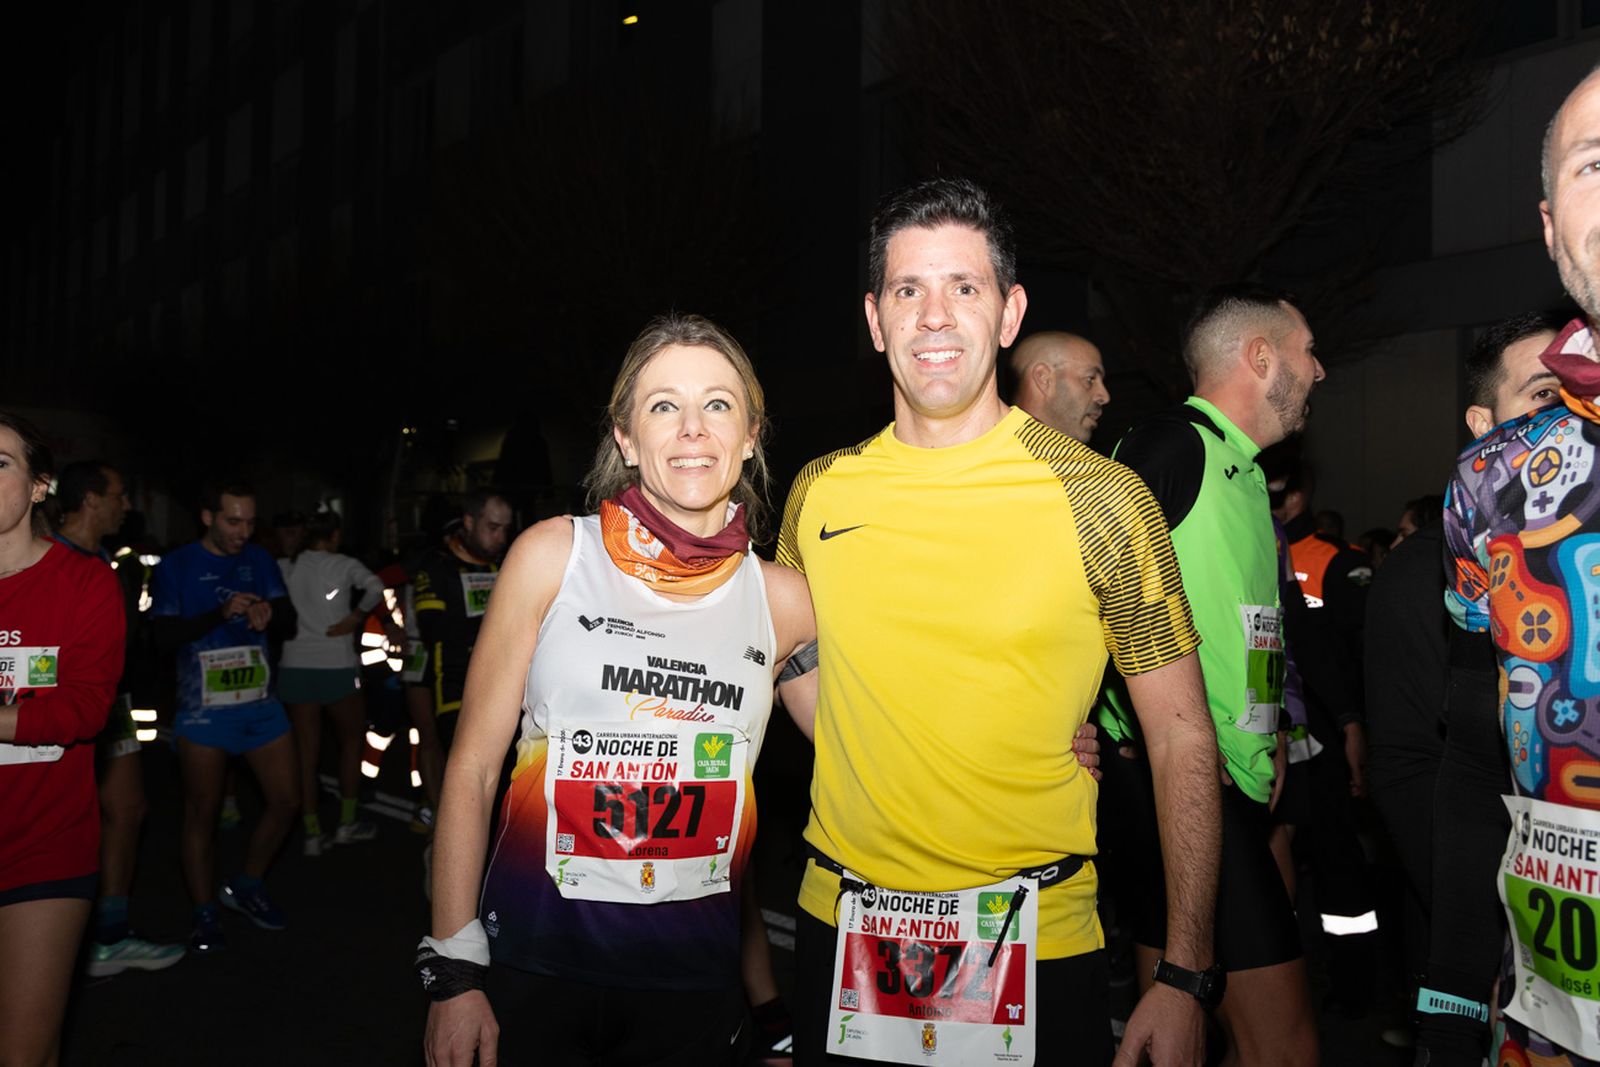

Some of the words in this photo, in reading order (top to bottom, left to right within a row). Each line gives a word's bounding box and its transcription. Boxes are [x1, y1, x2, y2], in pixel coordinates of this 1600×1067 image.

[607, 617, 635, 627] VALENCIA
[636, 628, 666, 639] ALFONSO
[1253, 635, 1268, 649] SAN
[220, 667, 256, 685] 4177
[646, 655, 708, 676] VALENCIA
[601, 664, 745, 711] MARATHON
[573, 733, 592, 748] 43
[595, 739, 653, 756] NOCHE
[657, 740, 679, 757] DE
[570, 760, 610, 779] SAN
[612, 758, 678, 780] ANTÓN
[593, 784, 706, 839] 5127
[1533, 818, 1555, 830] CARRERA
[1555, 823, 1578, 835] URBANA
[628, 846, 669, 857] Lorena
[1533, 828, 1598, 862] NOCHE
[1514, 851, 1549, 884] SAN
[1553, 863, 1600, 895] ANT
[861, 887, 876, 901] 43
[877, 895, 934, 915] NOCHE
[937, 898, 960, 916] DE
[861, 914, 893, 936] SAN
[895, 917, 960, 940] ANTÓN
[1528, 887, 1598, 971] 20
[876, 939, 993, 998] 3372
[1561, 972, 1592, 995] José
[908, 1003, 953, 1018] Antonio
